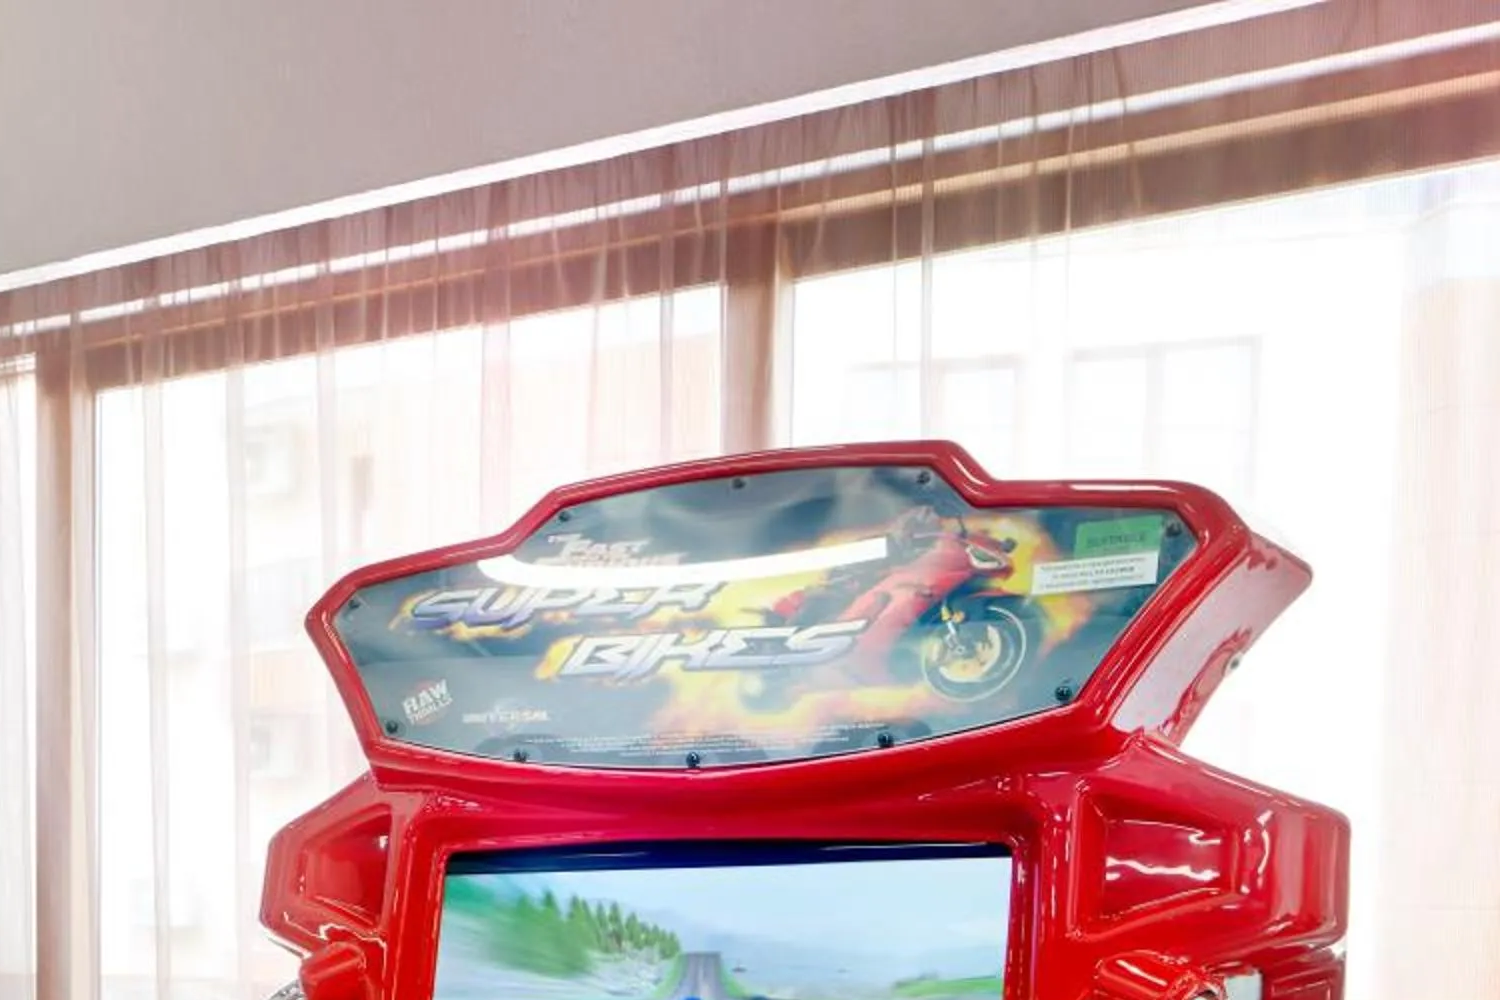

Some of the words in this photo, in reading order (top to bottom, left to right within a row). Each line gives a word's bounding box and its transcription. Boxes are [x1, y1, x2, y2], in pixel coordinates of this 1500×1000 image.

[412, 581, 732, 631] SUPER
[560, 619, 869, 681] BIKES
[402, 679, 449, 715] RAW
